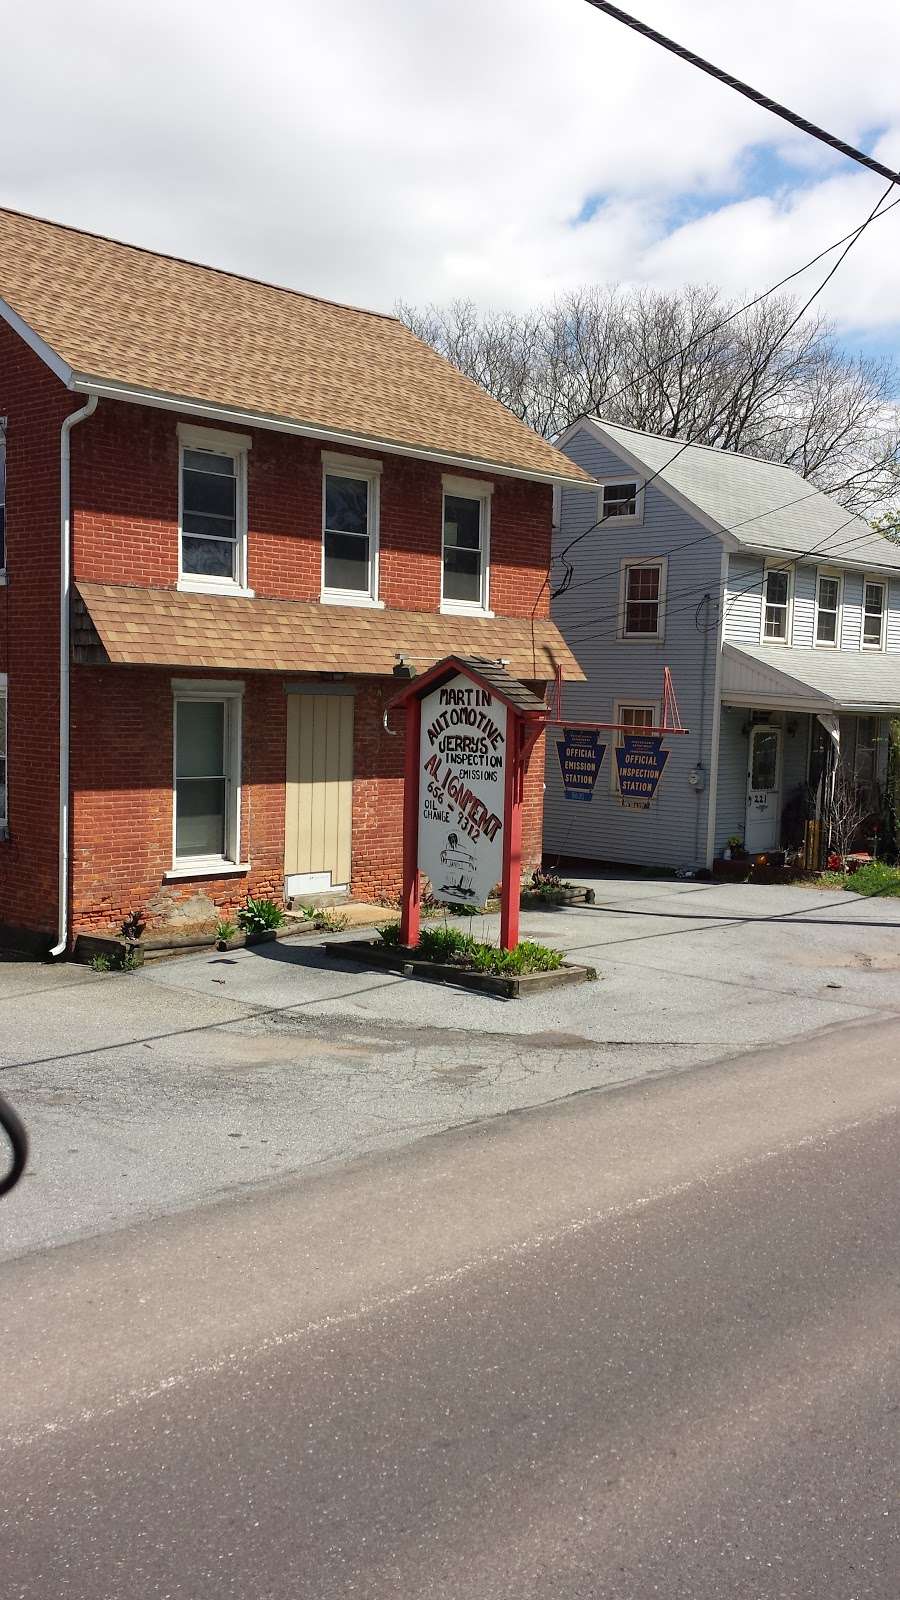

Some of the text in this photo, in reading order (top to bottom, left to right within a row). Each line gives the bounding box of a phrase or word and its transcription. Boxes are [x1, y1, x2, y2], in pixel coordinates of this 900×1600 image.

[439, 688, 493, 706] MARTIN
[427, 707, 505, 752] AUTOMOTIVE
[565, 747, 596, 759] OFFICIAL
[445, 753, 503, 768] INSPECTION
[564, 760, 596, 772] EMISSION
[625, 754, 657, 766] OFFICIAL
[459, 768, 498, 782] EMISSIONS
[564, 773, 593, 785] STATION
[619, 767, 660, 780] INSPECTION
[622, 780, 653, 792] STATION
[424, 753, 503, 843] ALIGNMENT
[754, 794, 767, 804] 221
[424, 799, 438, 811] OIL
[423, 809, 450, 824] CHANGE
